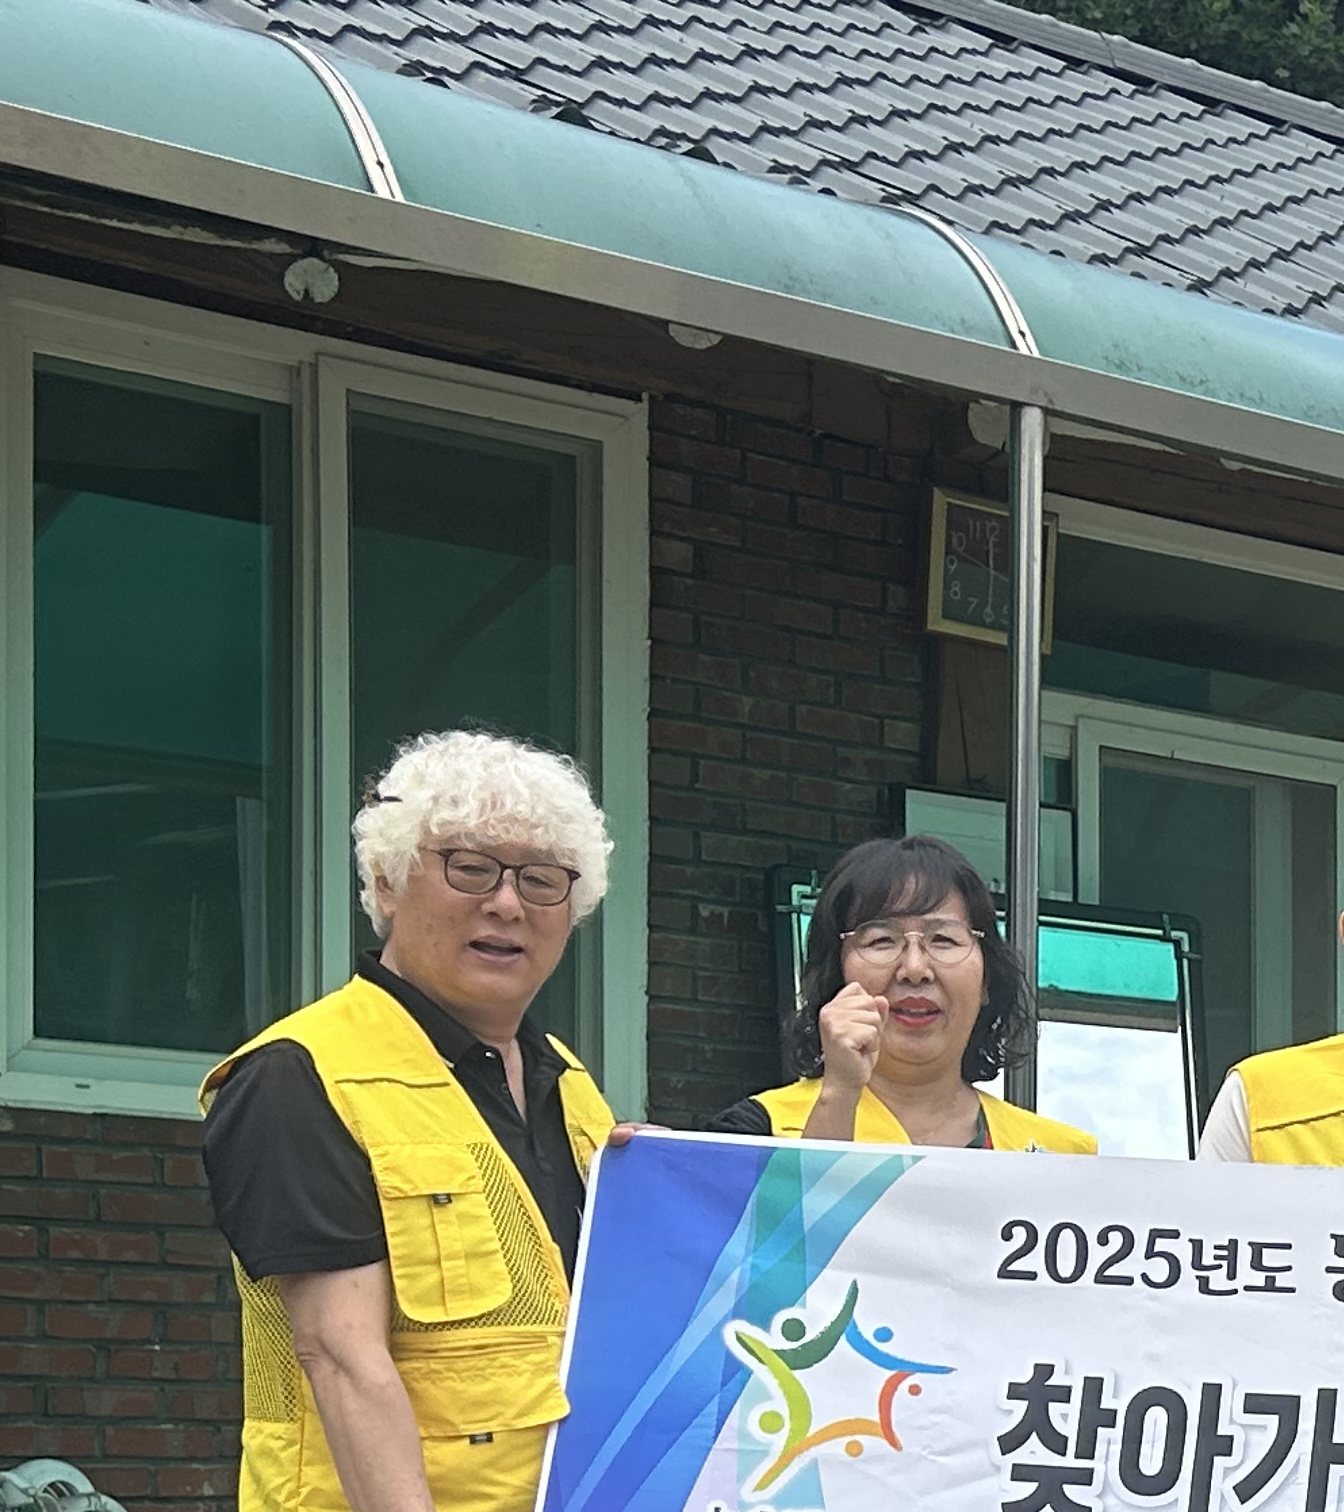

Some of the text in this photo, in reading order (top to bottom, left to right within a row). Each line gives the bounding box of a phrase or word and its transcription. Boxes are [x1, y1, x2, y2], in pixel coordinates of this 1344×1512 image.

[946, 555, 958, 573] 9
[950, 580, 961, 600] 8
[967, 597, 978, 615] 7
[997, 1219, 1296, 1297] 2025년도
